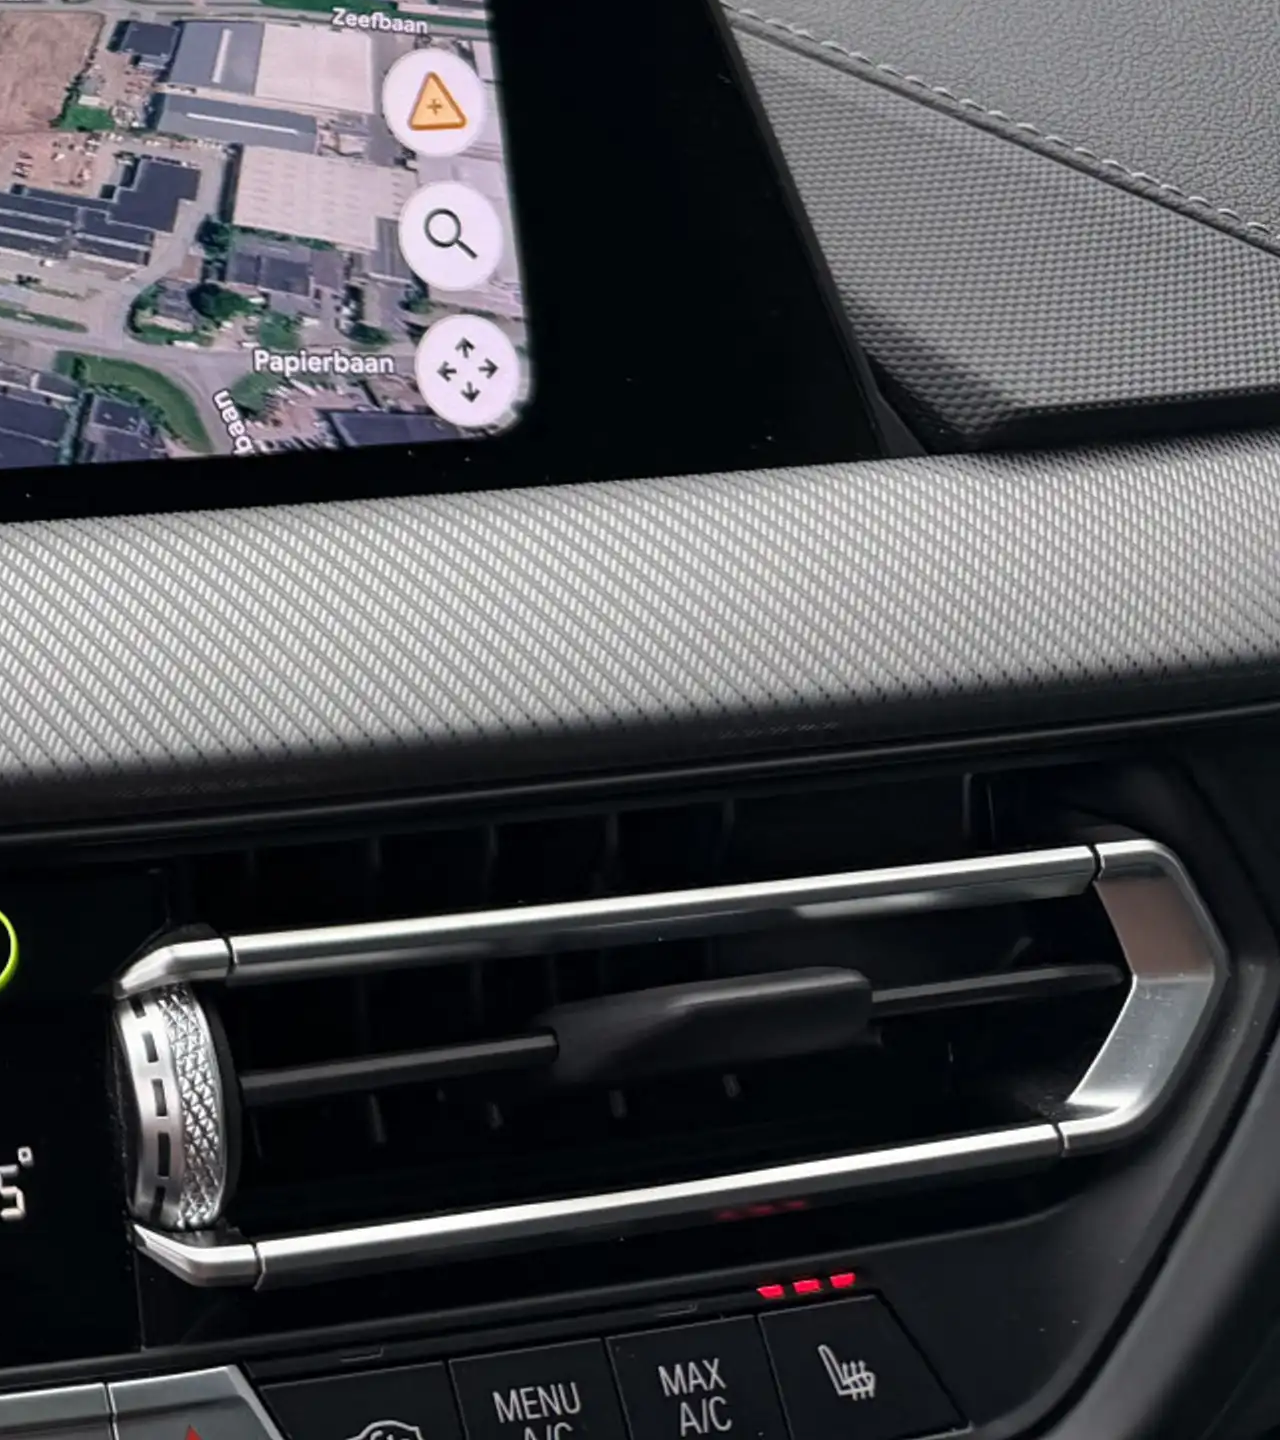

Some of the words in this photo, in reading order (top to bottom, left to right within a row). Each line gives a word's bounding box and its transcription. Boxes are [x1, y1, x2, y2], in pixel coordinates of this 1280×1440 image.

[332, 7, 428, 35] Zeefbaan
[253, 349, 394, 376] Papierbaan
[657, 1357, 726, 1397] MAX
[492, 1381, 582, 1423] MENU
[679, 1396, 733, 1437] A/C
